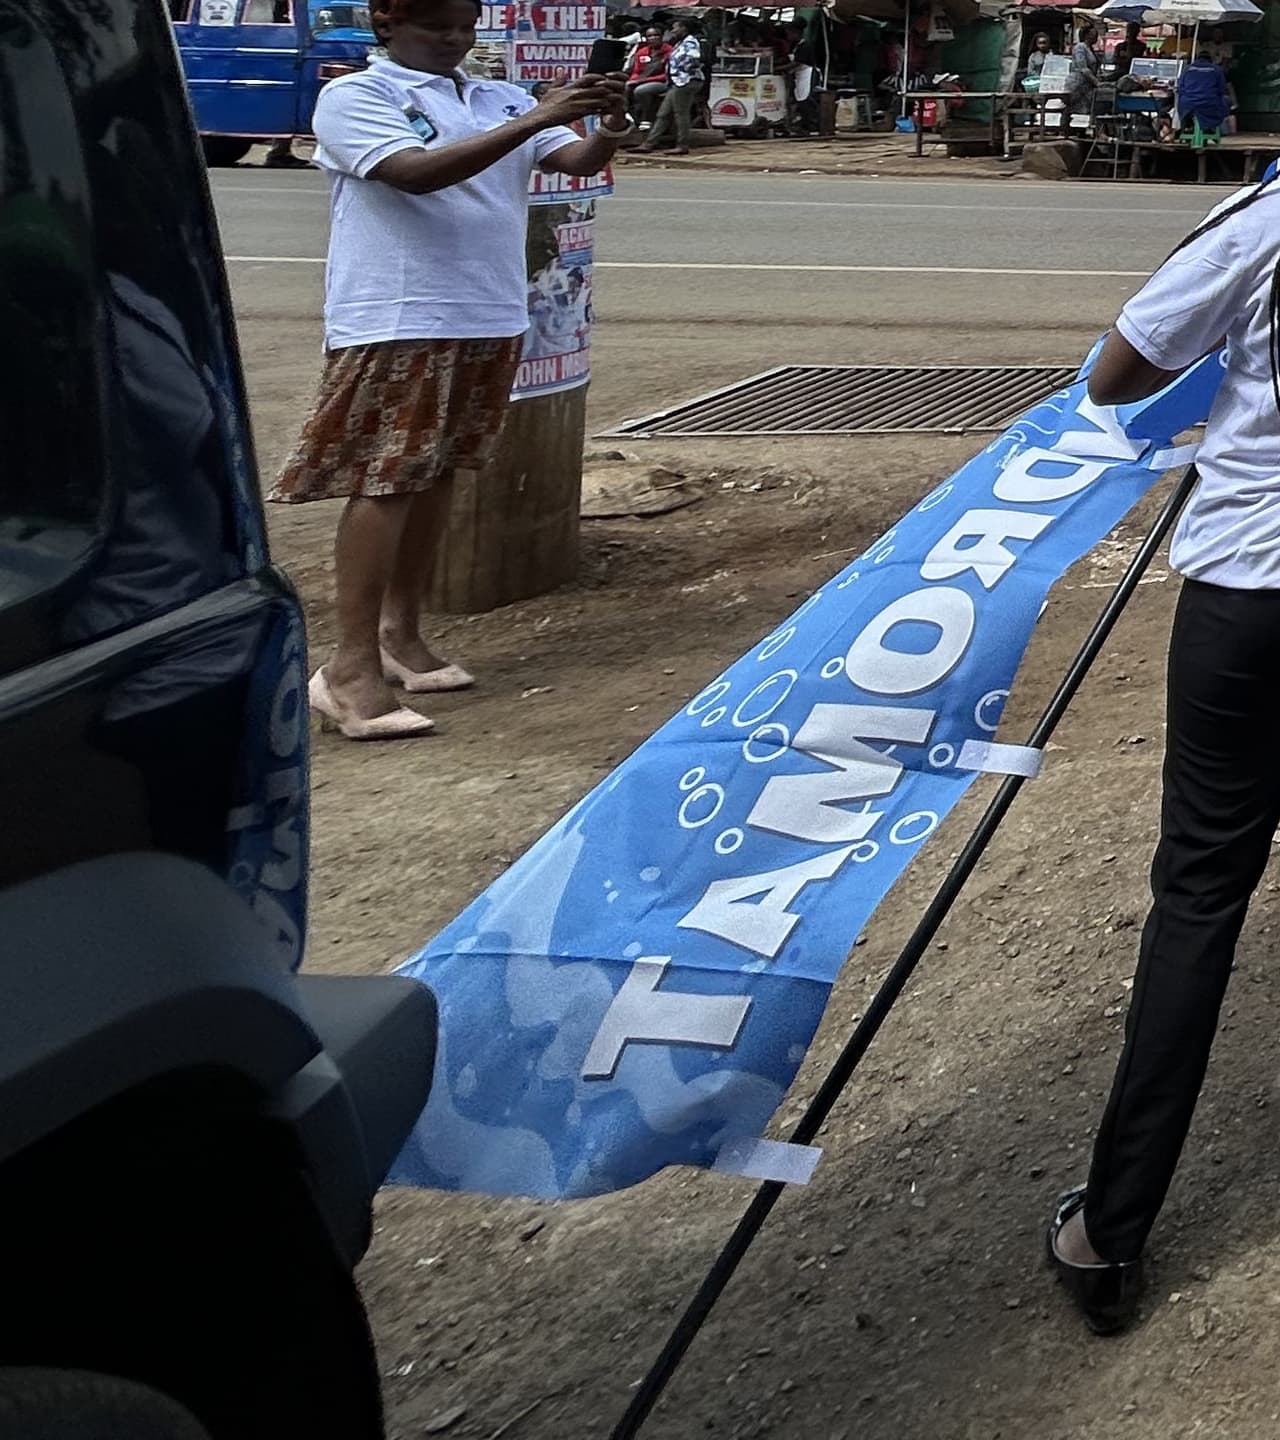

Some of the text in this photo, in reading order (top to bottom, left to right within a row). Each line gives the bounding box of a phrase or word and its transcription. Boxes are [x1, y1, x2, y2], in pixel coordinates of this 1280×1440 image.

[475, 5, 507, 30] DE
[541, 6, 588, 30] THE
[523, 45, 587, 61] WANJA
[521, 65, 582, 80] MUGIT
